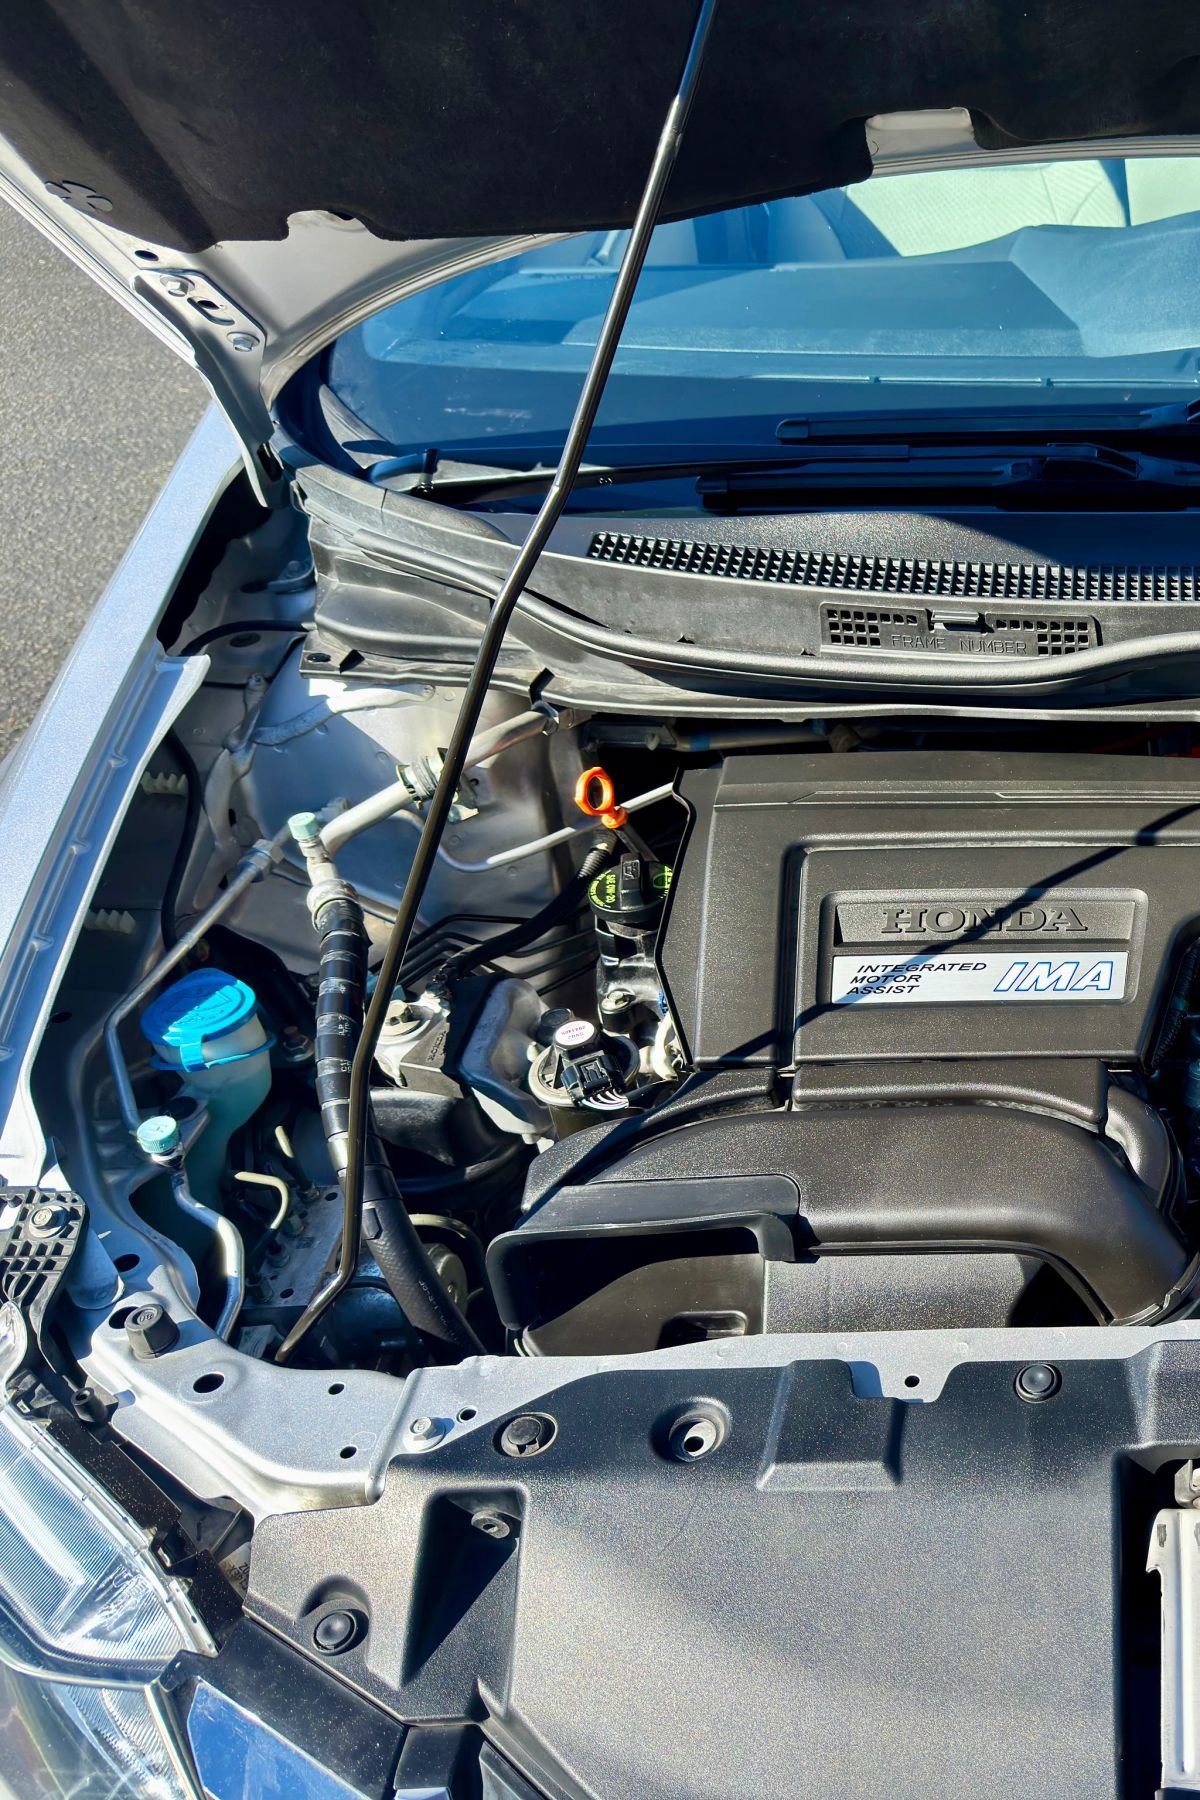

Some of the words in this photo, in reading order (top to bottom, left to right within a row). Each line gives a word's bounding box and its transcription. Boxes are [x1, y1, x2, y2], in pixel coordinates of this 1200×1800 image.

[891, 635, 946, 650] FRAME
[959, 638, 1027, 654] NUMBER
[881, 906, 1088, 934] HONDA
[857, 962, 987, 973] INTEGRATED
[850, 974, 922, 984] MOTOR
[993, 961, 1114, 992] IMA
[846, 985, 920, 995] ASSIST
